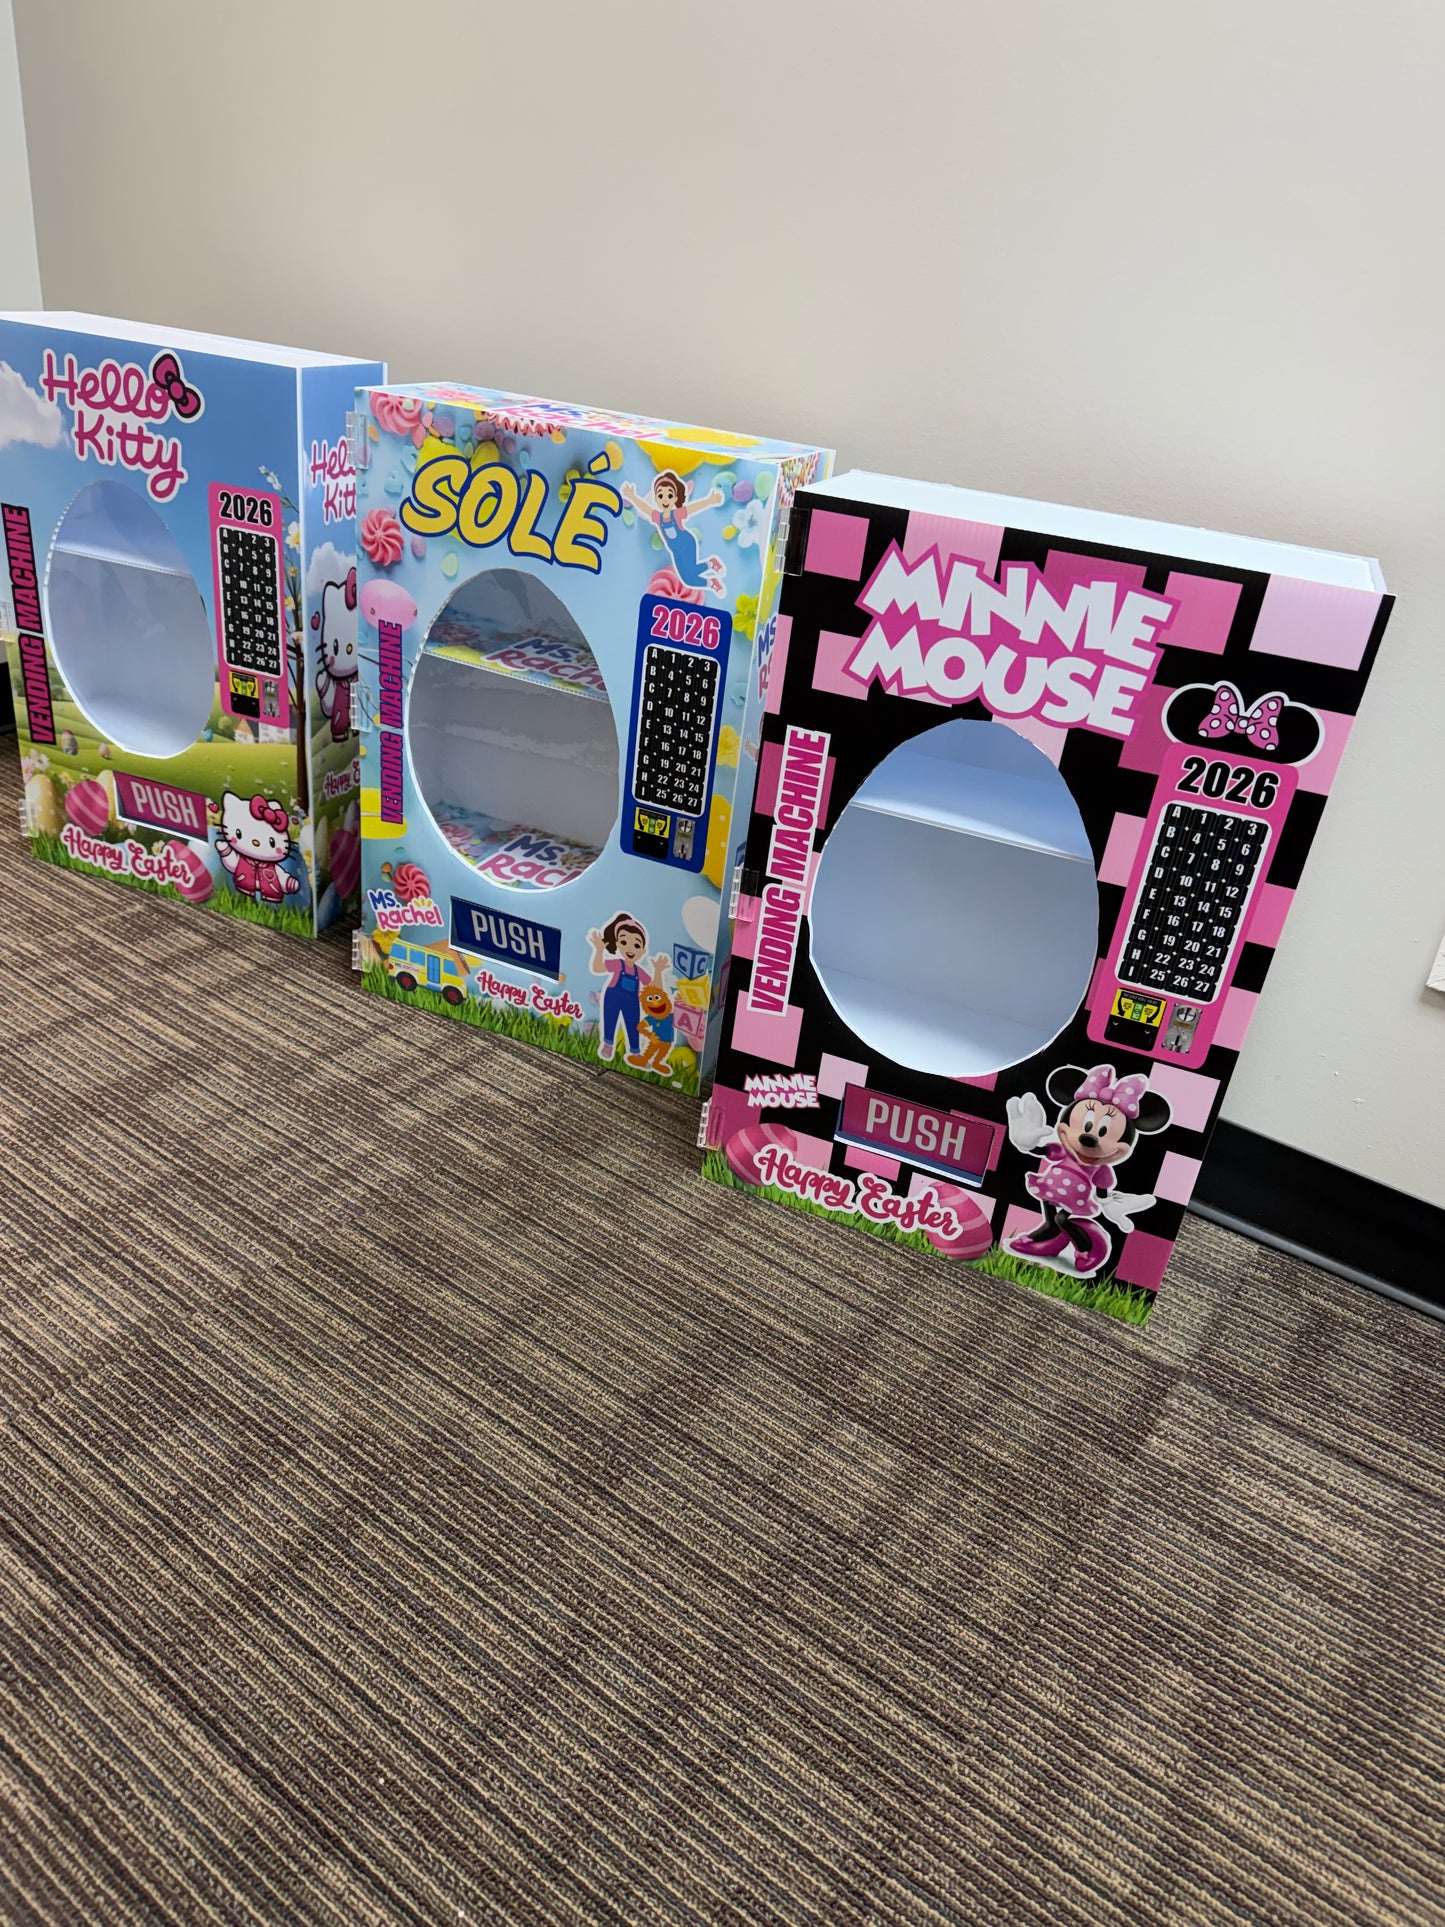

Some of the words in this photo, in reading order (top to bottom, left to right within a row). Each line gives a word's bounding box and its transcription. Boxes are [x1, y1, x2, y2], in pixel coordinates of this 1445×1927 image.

[43, 353, 168, 419] Hello
[74, 410, 184, 498] Kitty
[311, 439, 356, 484] Hel
[219, 491, 273, 527] 2026
[400, 451, 624, 575] SOLÉ
[223, 529, 228, 538] A
[238, 532, 242, 541] 1
[251, 535, 257, 544] 2
[264, 538, 270, 547] 3
[223, 544, 229, 553] B
[238, 547, 243, 557] 4
[252, 550, 257, 560] 5
[265, 553, 271, 562] 6
[2, 505, 43, 633] MACHINE
[224, 559, 230, 568] C
[239, 562, 243, 572] 7
[252, 566, 258, 575] 8
[266, 568, 271, 578] 9
[225, 575, 231, 584] D
[226, 591, 231, 601] E
[862, 549, 1174, 670] MINNIE
[228, 623, 234, 633] G
[651, 605, 721, 650] 2026
[231, 652, 235, 661] I
[651, 648, 658, 659] A
[671, 653, 675, 663] 1
[688, 657, 694, 668] 2
[704, 661, 710, 672] 3
[19, 633, 55, 744] VENDING
[378, 619, 404, 729] MACHINE
[650, 665, 656, 676] B
[668, 670, 674, 681] 4
[685, 675, 692, 685] 5
[702, 679, 708, 689] 6
[849, 620, 1148, 737] MOUSE
[649, 682, 655, 693] C
[667, 688, 672, 698] 7
[684, 692, 690, 703] 8
[700, 696, 707, 706] 9
[647, 701, 653, 711] D
[665, 707, 674, 717] 10
[682, 712, 690, 722] 11
[697, 715, 706, 725] 12
[646, 719, 651, 729] E
[663, 725, 672, 735] 13
[680, 729, 688, 739] 14
[695, 733, 704, 743] 15
[644, 737, 649, 746] F
[661, 741, 670, 752] 16
[678, 746, 686, 756] 17
[692, 750, 702, 760] 18
[380, 730, 404, 825] VENDING
[643, 755, 649, 765] G
[660, 759, 669, 769] 19
[675, 762, 686, 773] 20
[691, 766, 701, 777] 21
[641, 772, 648, 781] H
[657, 774, 668, 785] 22
[674, 778, 685, 789] 23
[688, 782, 699, 793] 24
[641, 787, 645, 796] I
[656, 788, 667, 799] 25
[672, 793, 683, 803] 26
[688, 797, 698, 807] 27
[1177, 756, 1279, 809] 2026
[130, 781, 199, 829] PUSH
[770, 729, 826, 882] MACHINE
[1172, 806, 1181, 818] A
[1201, 813, 1207, 824] 1
[1224, 818, 1234, 830] 2
[1247, 823, 1257, 835] 3
[64, 827, 128, 872] Happy
[127, 843, 191, 884] Easter
[1166, 826, 1176, 838] B
[1192, 833, 1201, 844] 4
[1217, 838, 1227, 851] 5
[1241, 844, 1251, 856] 6
[1161, 846, 1170, 858] C
[1187, 852, 1195, 864] 7
[1211, 859, 1220, 871] 8
[1235, 864, 1244, 876] 9
[1154, 867, 1164, 879] D
[1180, 875, 1193, 887] 10
[1205, 881, 1217, 893] 11
[1226, 886, 1239, 898] 12
[377, 904, 442, 930] Rachel
[1149, 888, 1157, 900] E
[1174, 895, 1187, 907] 13
[1197, 901, 1210, 913] 14
[1219, 906, 1232, 918] 15
[470, 909, 546, 962] PUSH
[1143, 909, 1151, 919] F
[1167, 915, 1180, 926] 16
[1192, 921, 1204, 932] 17
[1212, 926, 1226, 938] 18
[751, 886, 801, 1013] VENDING
[1137, 929, 1147, 941] G
[1163, 934, 1176, 946] 19
[1183, 940, 1200, 952] 20
[1206, 945, 1221, 958] 21
[677, 951, 688, 972] C
[697, 957, 706, 974] C
[1131, 948, 1141, 960] H
[1154, 953, 1171, 965] 22
[1178, 958, 1194, 970] 23
[1198, 964, 1215, 976] 24
[1128, 966, 1134, 976] I
[1149, 969, 1166, 981] 25
[1173, 975, 1189, 987] 26
[1194, 981, 1210, 992] 27
[477, 971, 529, 1006] Happy
[531, 985, 583, 1019] Easter
[677, 1012, 693, 1032] A
[745, 1074, 817, 1092] MINNIE
[748, 1091, 819, 1108] MOUSE
[866, 1098, 967, 1160] PUSH
[758, 1149, 854, 1209] Happy
[861, 1177, 958, 1236] Easter
